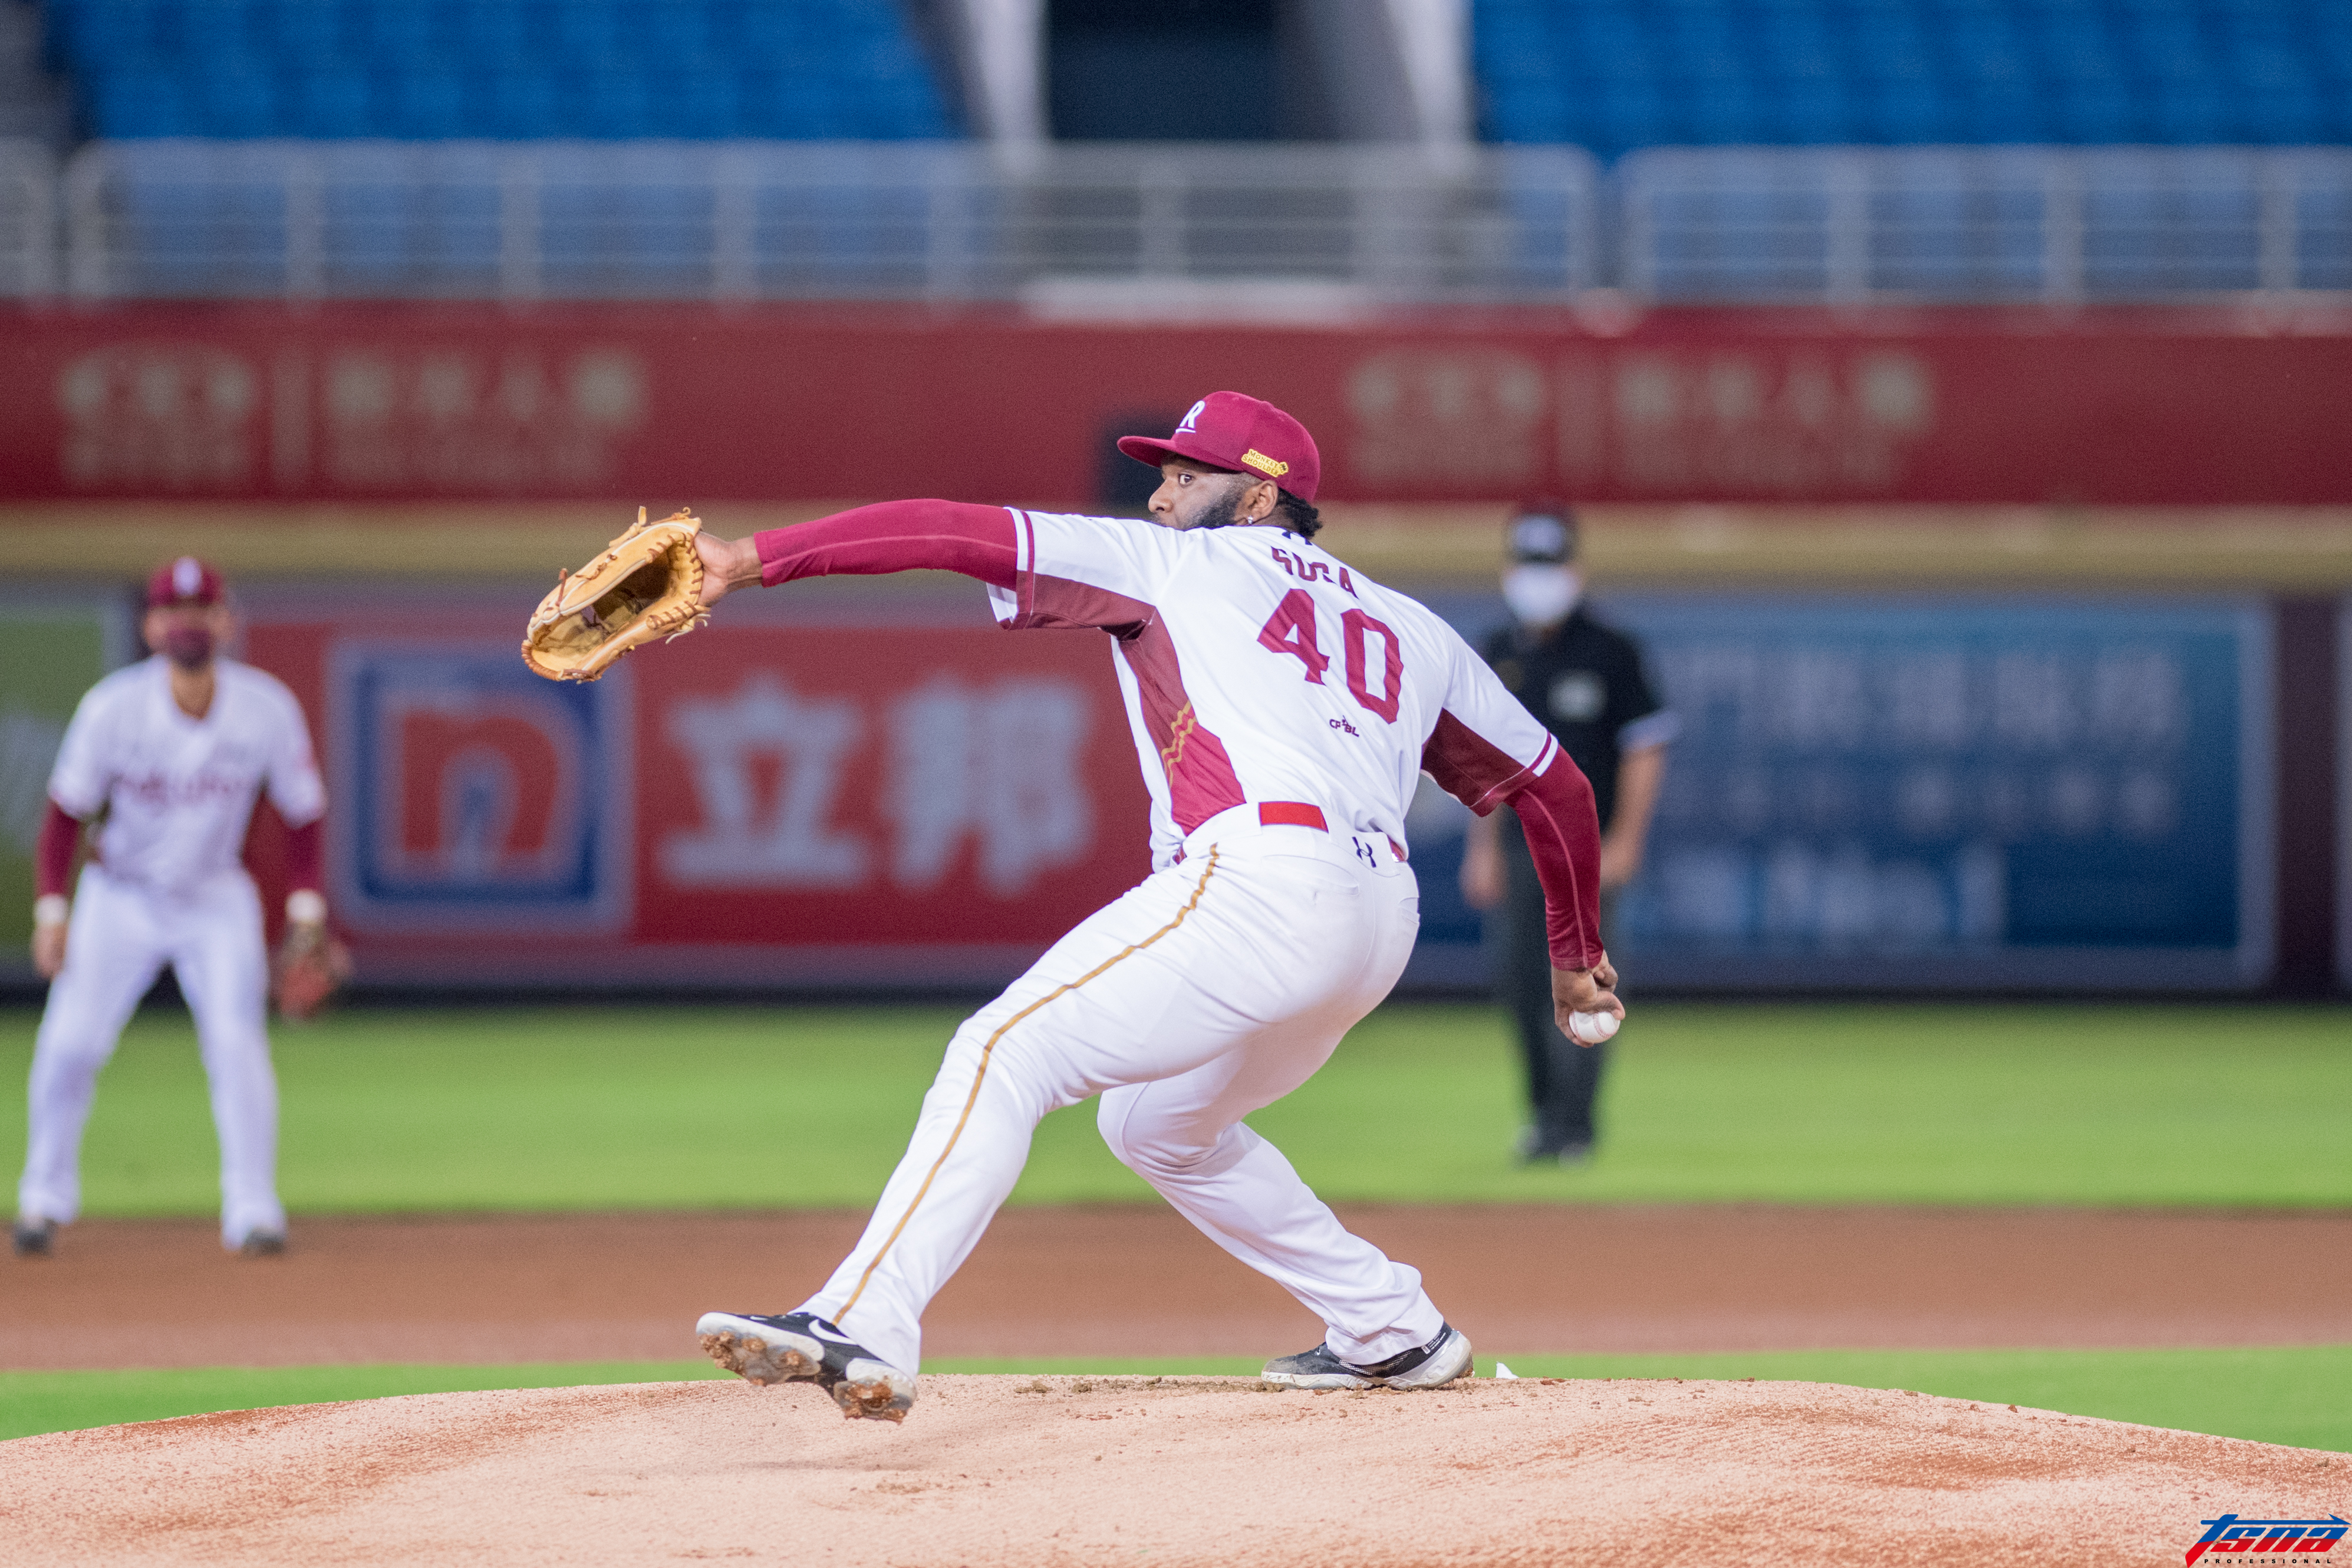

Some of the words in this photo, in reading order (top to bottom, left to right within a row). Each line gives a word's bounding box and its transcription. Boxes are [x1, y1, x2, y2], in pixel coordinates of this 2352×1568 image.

[1178, 400, 1205, 429] R
[1243, 455, 1278, 476] SHOULDER
[1250, 450, 1279, 468] MONKEY
[1257, 588, 1404, 724] 40
[1329, 716, 1359, 737] CPBL
